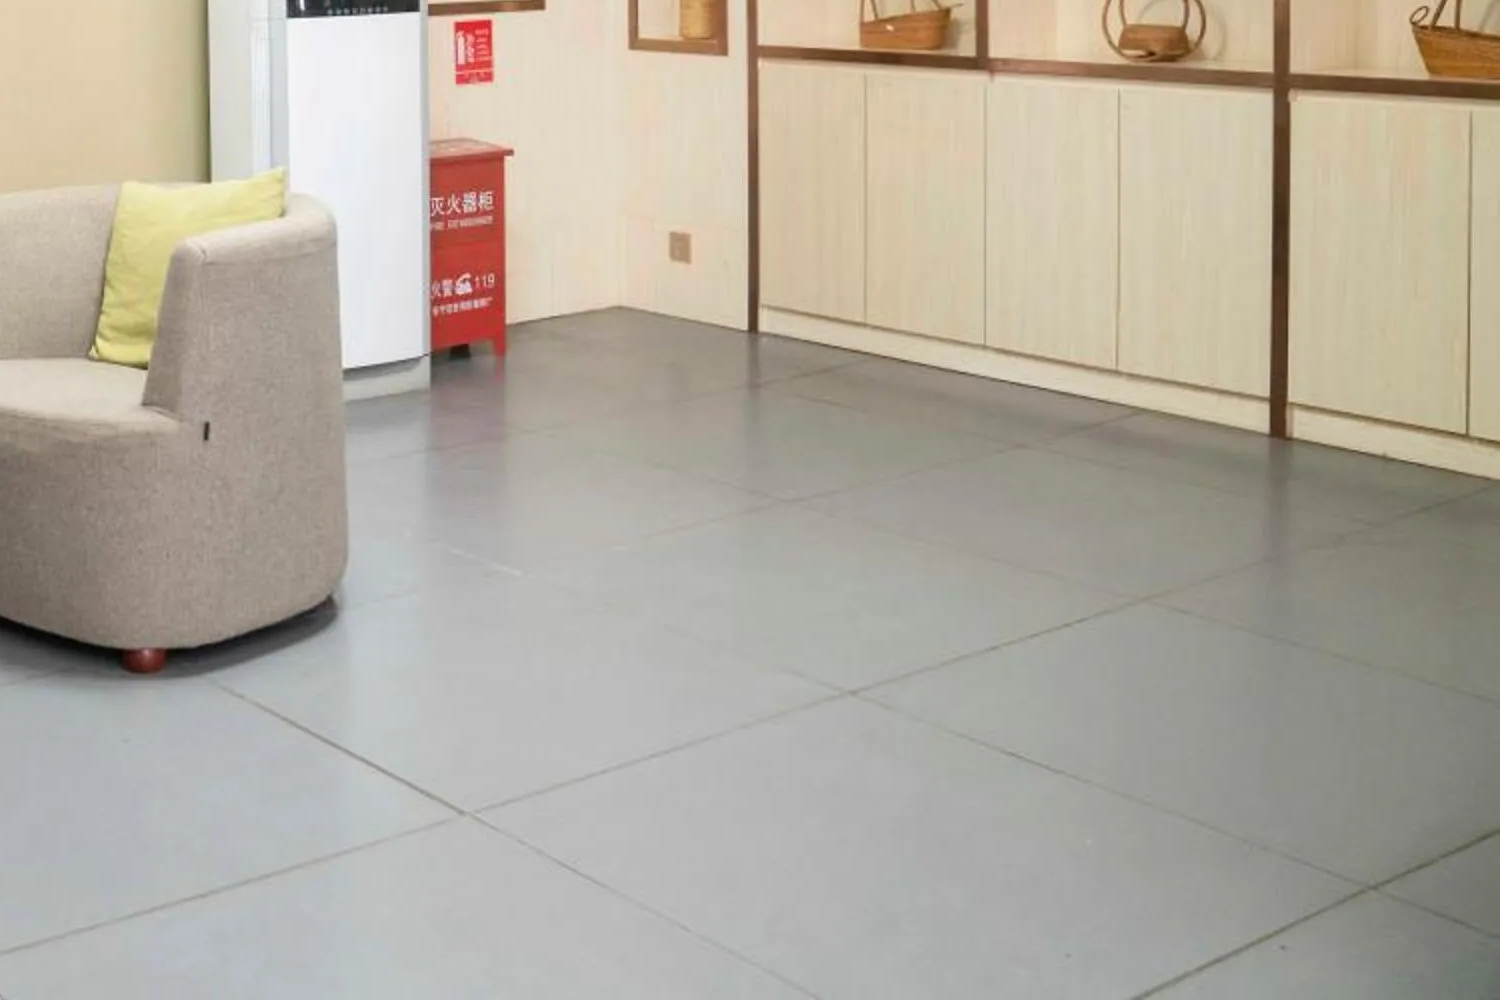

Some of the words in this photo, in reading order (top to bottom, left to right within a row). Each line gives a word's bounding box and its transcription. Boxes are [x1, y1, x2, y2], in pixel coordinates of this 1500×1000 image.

[431, 191, 494, 216] 灭火器柜
[475, 273, 495, 288] 119
